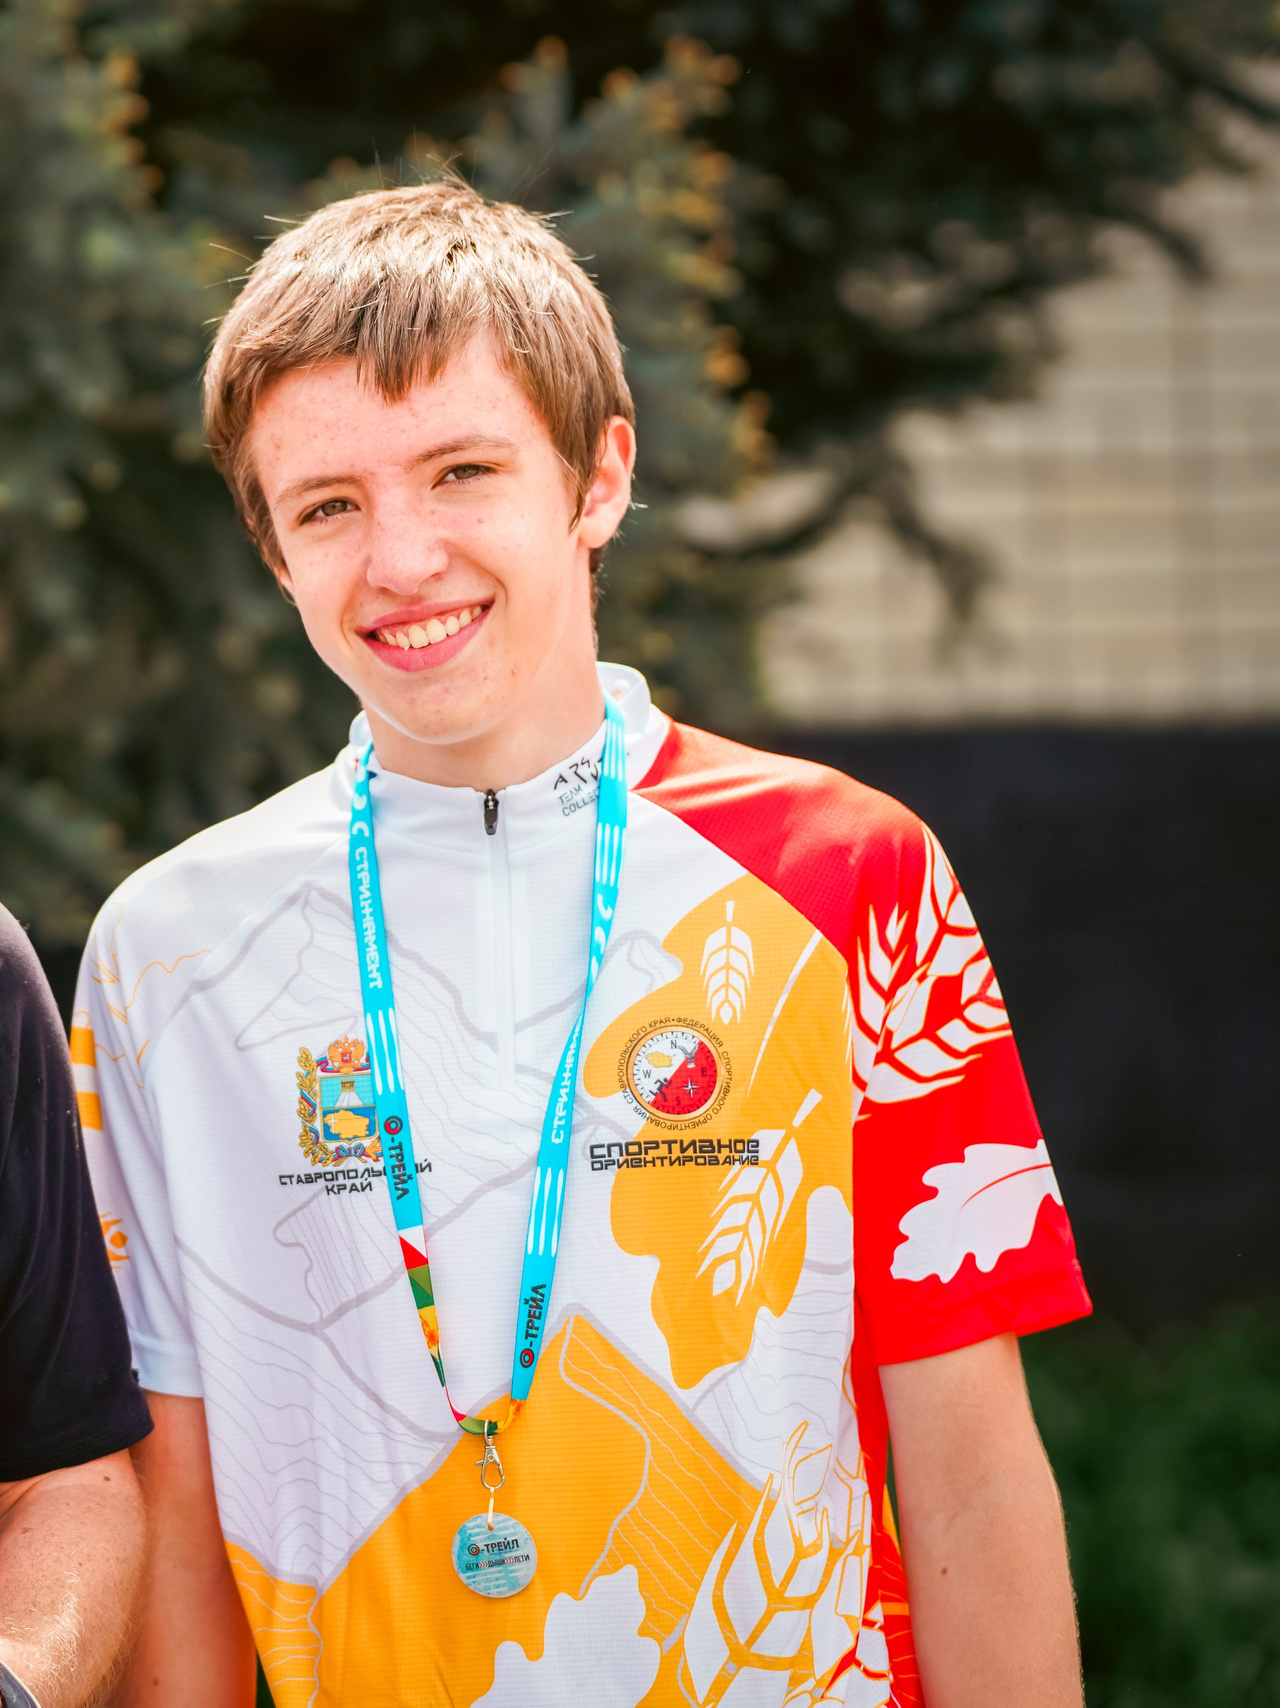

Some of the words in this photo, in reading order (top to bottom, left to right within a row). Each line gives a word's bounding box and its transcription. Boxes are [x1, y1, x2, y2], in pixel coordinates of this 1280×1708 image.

[558, 784, 582, 804] TEAM
[562, 787, 600, 816] COLLEC
[648, 1016, 671, 1028] КРАЯ
[676, 1017, 724, 1048] ФЕДЕРАЦИЯ
[670, 1039, 678, 1049] N
[617, 1025, 648, 1105] СТАВРОПОЛЬСКОГО
[642, 1069, 652, 1079] W
[711, 1050, 733, 1115] СПОРТИВНОГО
[632, 1105, 713, 1131] ОРИЕНТИРОВАНИЯ
[589, 1138, 760, 1160] СПОРТИВНОЕ
[278, 1158, 433, 1186] СТАВРОПОЛЬЙ
[590, 1154, 760, 1172] ОРИЕНТИРОВАНИЕ
[325, 1177, 373, 1196] КРАЙ
